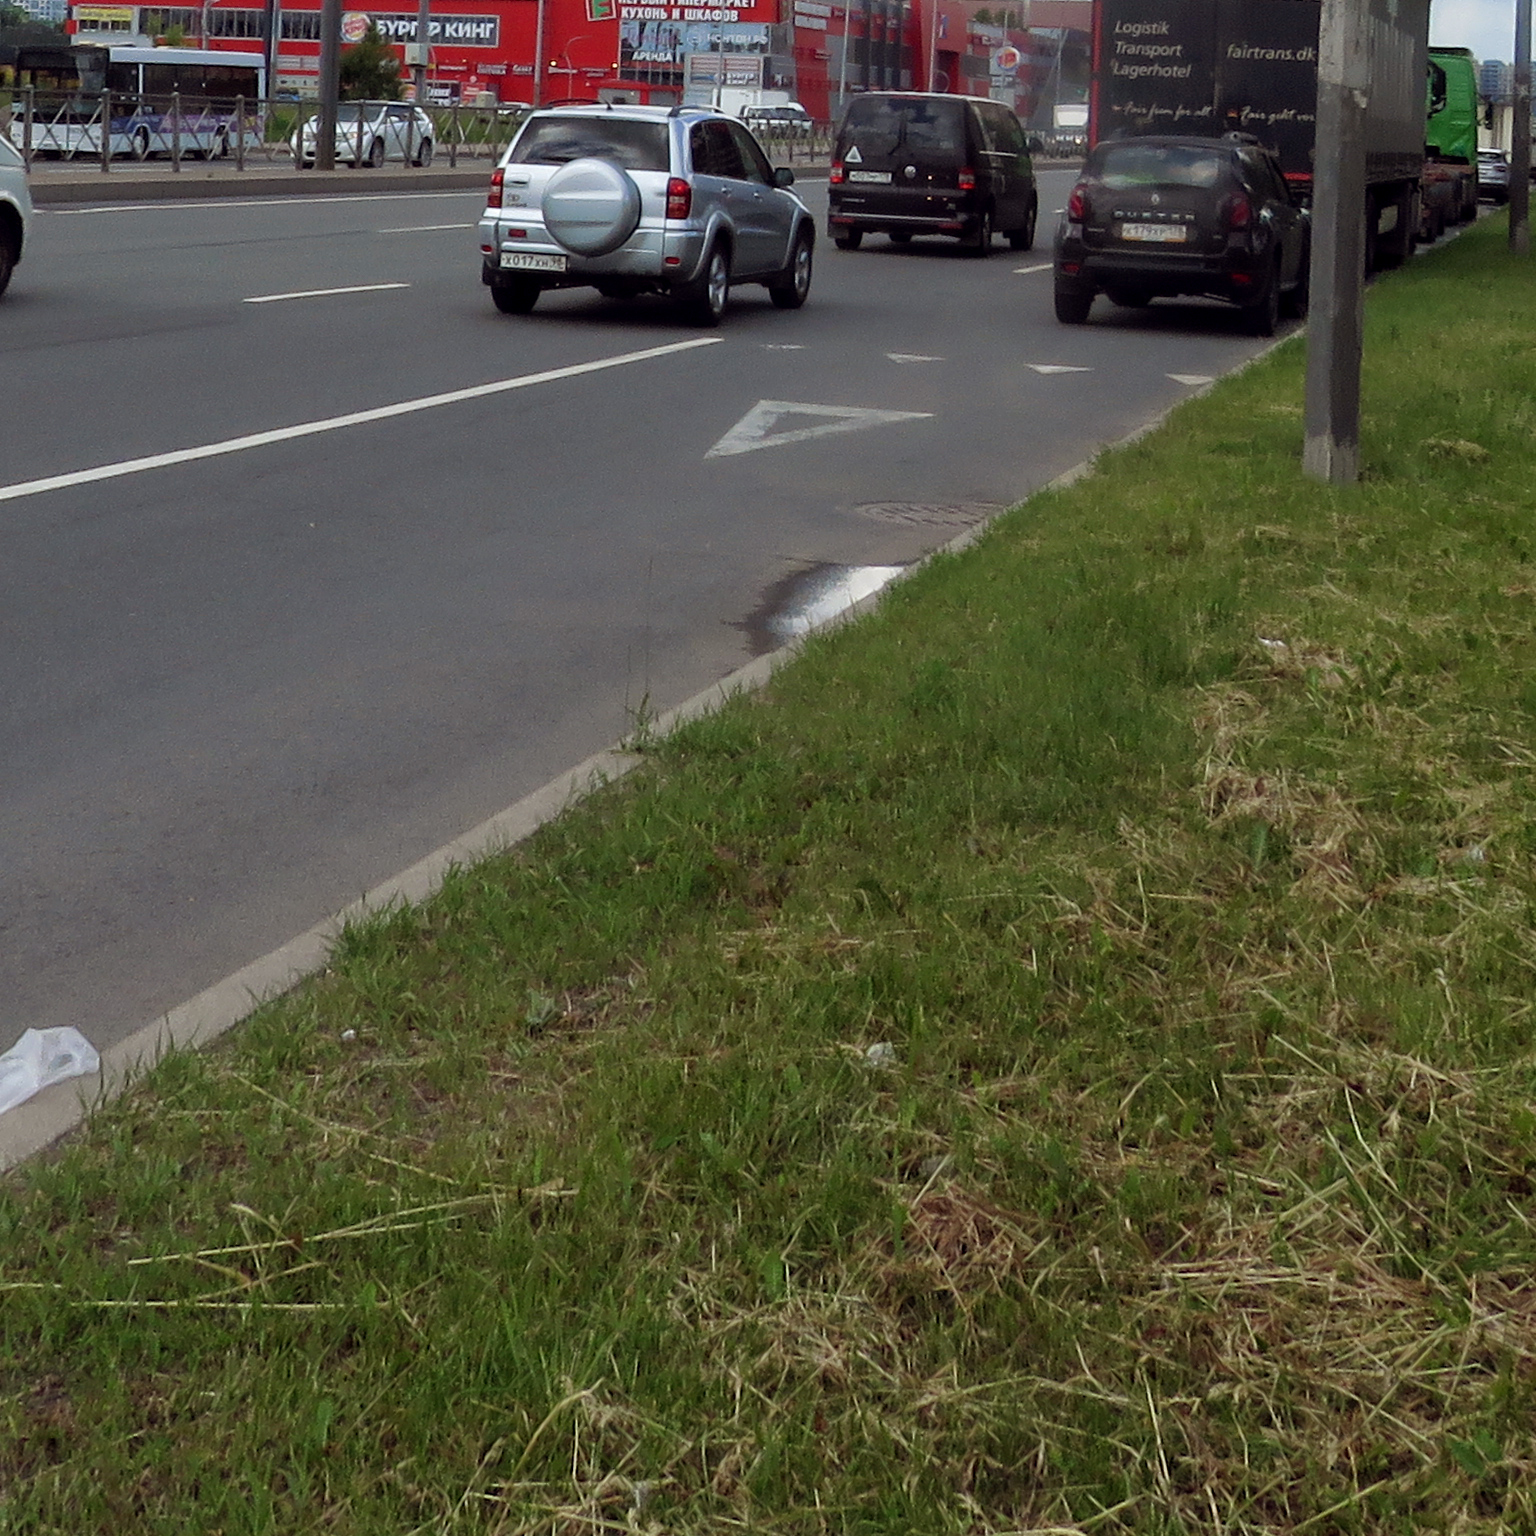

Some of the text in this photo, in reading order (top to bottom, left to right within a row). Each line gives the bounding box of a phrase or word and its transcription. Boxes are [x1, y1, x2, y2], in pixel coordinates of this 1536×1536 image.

[621, 6, 739, 22] КУХОНЬ И ШКАФОВ
[445, 22, 495, 39] КИНГ
[1115, 20, 1170, 37] Logistik
[632, 51, 673, 63] АРЕНДА
[1115, 41, 1183, 58] Transport
[1227, 43, 1317, 61] fairtrans.dk
[1114, 63, 1191, 79] Lagerhotel
